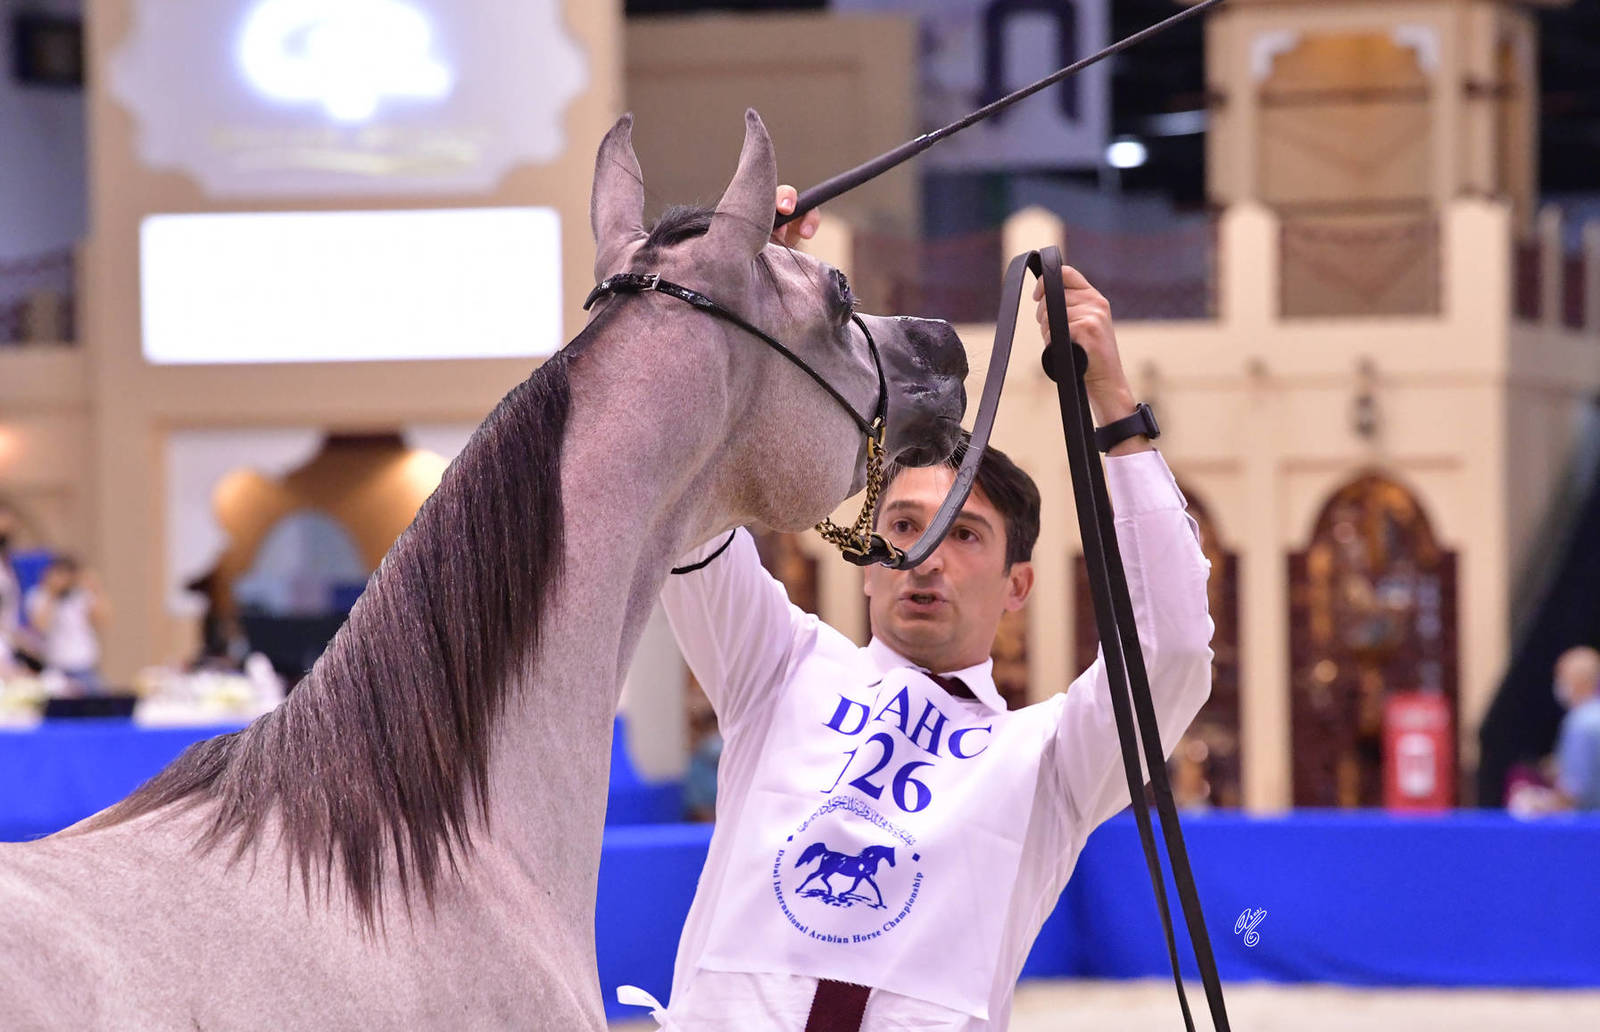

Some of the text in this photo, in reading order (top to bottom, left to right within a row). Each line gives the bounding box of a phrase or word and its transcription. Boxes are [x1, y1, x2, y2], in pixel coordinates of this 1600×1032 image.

[821, 685, 993, 759] DAHC
[773, 849, 924, 944] Dubai International Arabian Horse Championship
